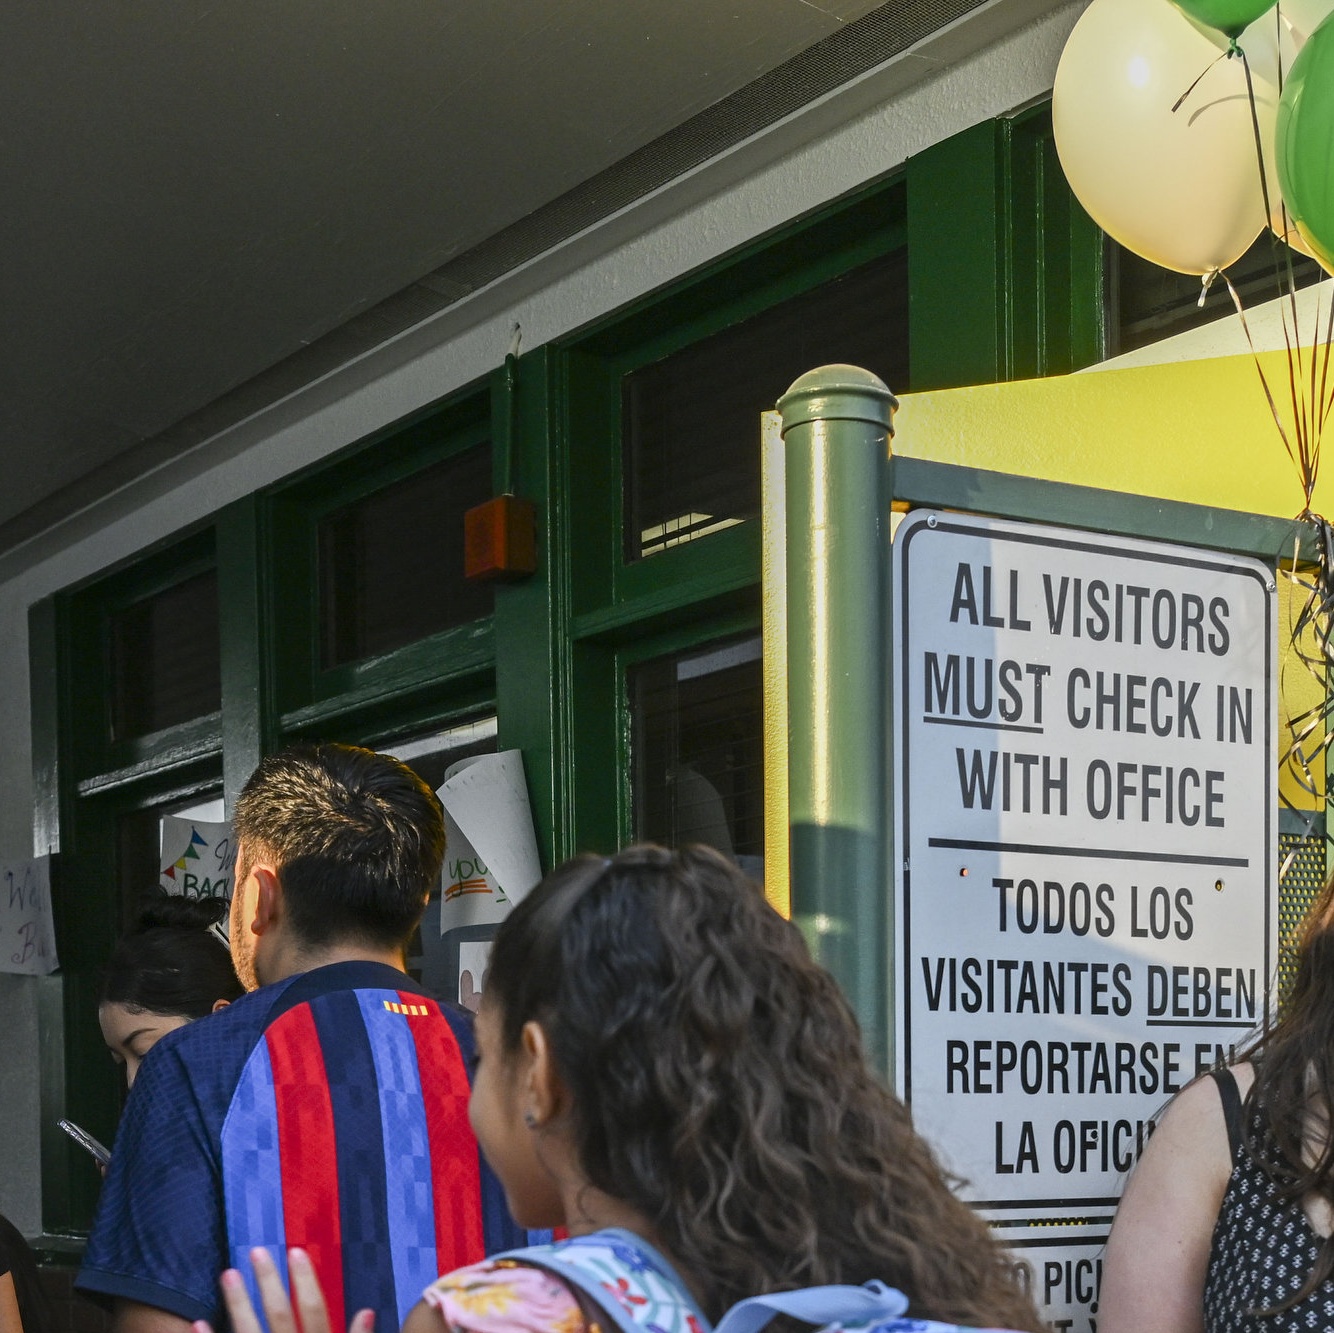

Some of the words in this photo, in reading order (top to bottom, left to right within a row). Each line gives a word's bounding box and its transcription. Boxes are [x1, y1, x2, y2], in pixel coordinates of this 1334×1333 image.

[949, 562, 1031, 632] ALL
[1042, 573, 1230, 656] VISITORS
[923, 651, 1051, 724] MUST
[1067, 667, 1201, 740] CHECK
[1216, 685, 1253, 745] IN
[956, 747, 1068, 816] WITH
[1086, 758, 1225, 828] OFFICE
[992, 878, 1115, 938] TODOS
[1131, 886, 1193, 940] LOS
[921, 956, 1132, 1017] VISITANTES
[1147, 966, 1256, 1019] DEBEN
[947, 1040, 1181, 1094] REPORTARSE
[995, 1120, 1039, 1174] LA
[1053, 1119, 1156, 1174] OFICI
